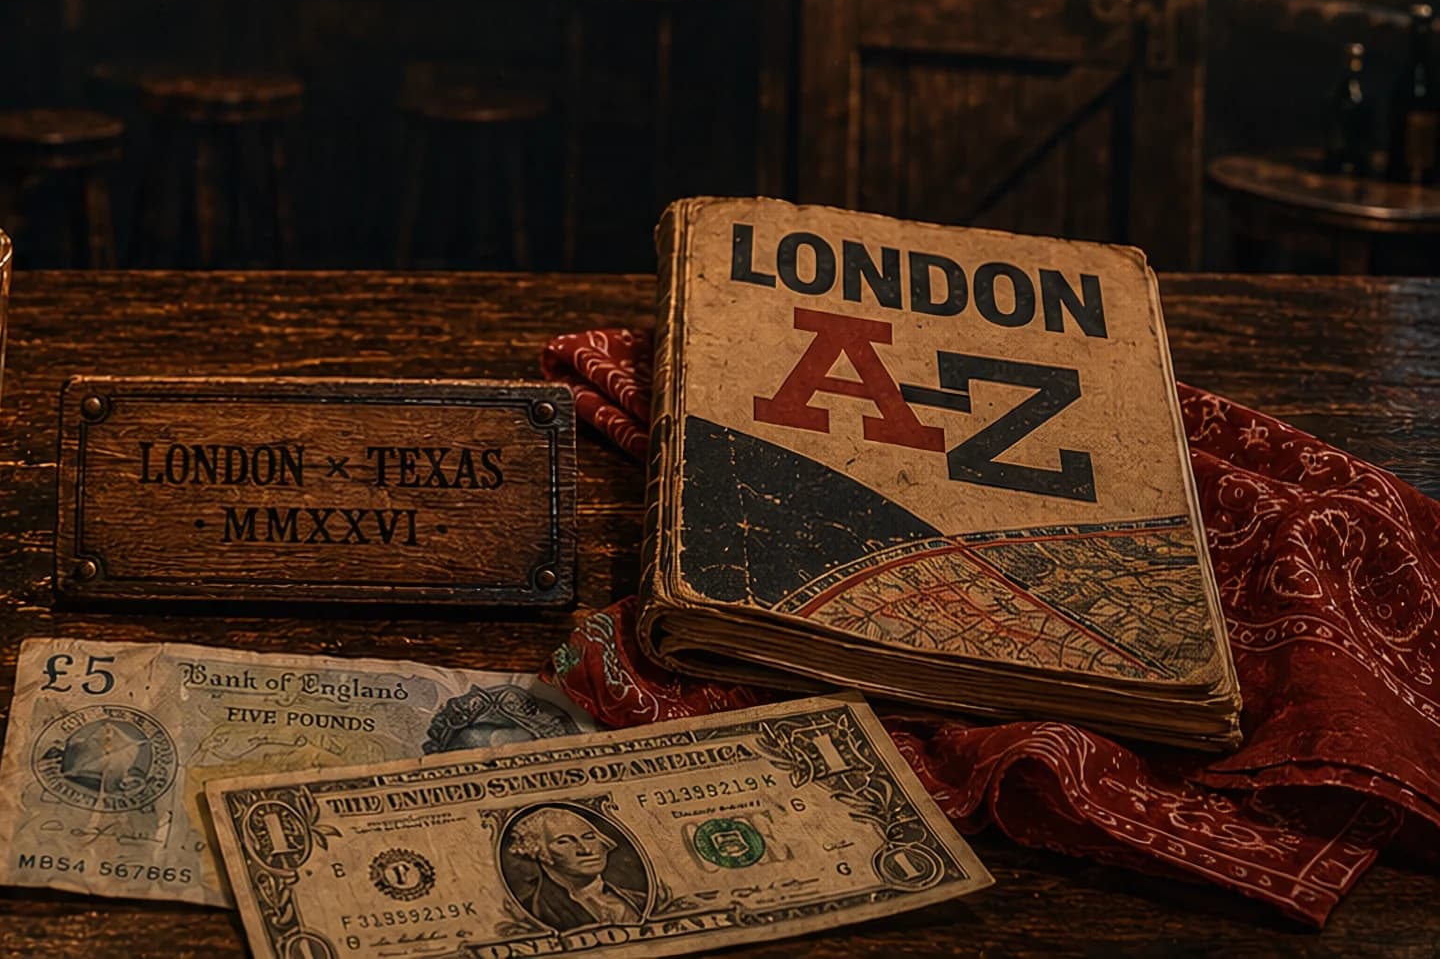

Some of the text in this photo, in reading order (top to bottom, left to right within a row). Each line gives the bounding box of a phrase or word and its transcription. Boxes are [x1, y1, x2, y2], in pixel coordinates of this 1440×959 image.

[730, 223, 1108, 339] LONDON
[753, 306, 1098, 503] A-Z
[138, 442, 306, 487] LONDON
[367, 446, 504, 490] TEXAS
[221, 507, 418, 542] MMXXVI
[40, 654, 115, 695] £5
[178, 662, 409, 703] Bank of England
[226, 706, 376, 732] FIVE POUNDS
